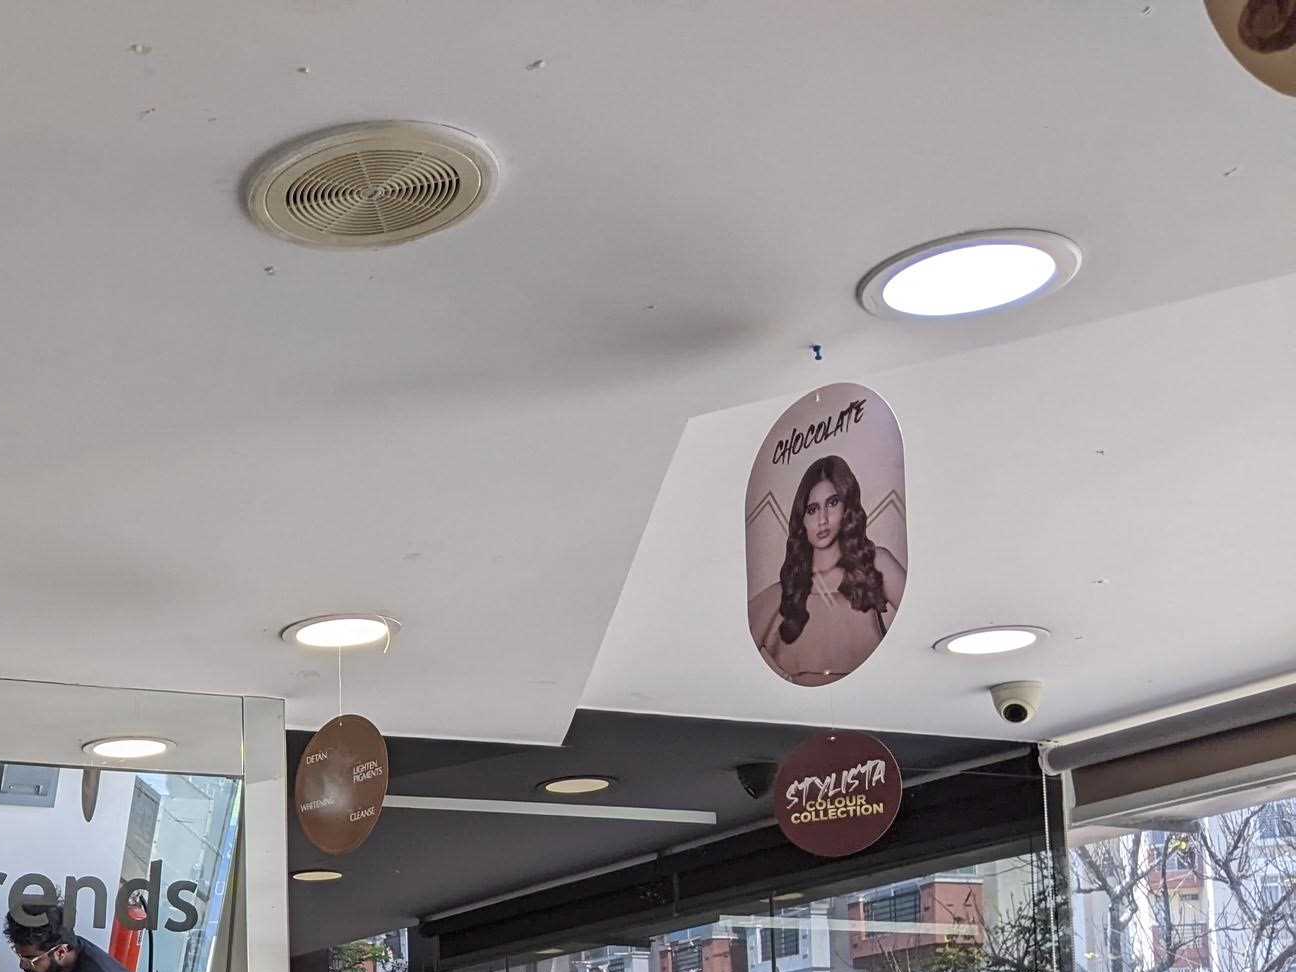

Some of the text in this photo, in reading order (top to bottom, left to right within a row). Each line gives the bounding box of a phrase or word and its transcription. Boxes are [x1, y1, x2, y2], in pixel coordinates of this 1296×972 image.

[772, 400, 866, 464] CHOCOLATE
[785, 759, 886, 810] STYLISTA
[349, 806, 376, 822] CLEANSE
[790, 802, 884, 824] COLLECTION
[806, 794, 867, 812] COLOUR
